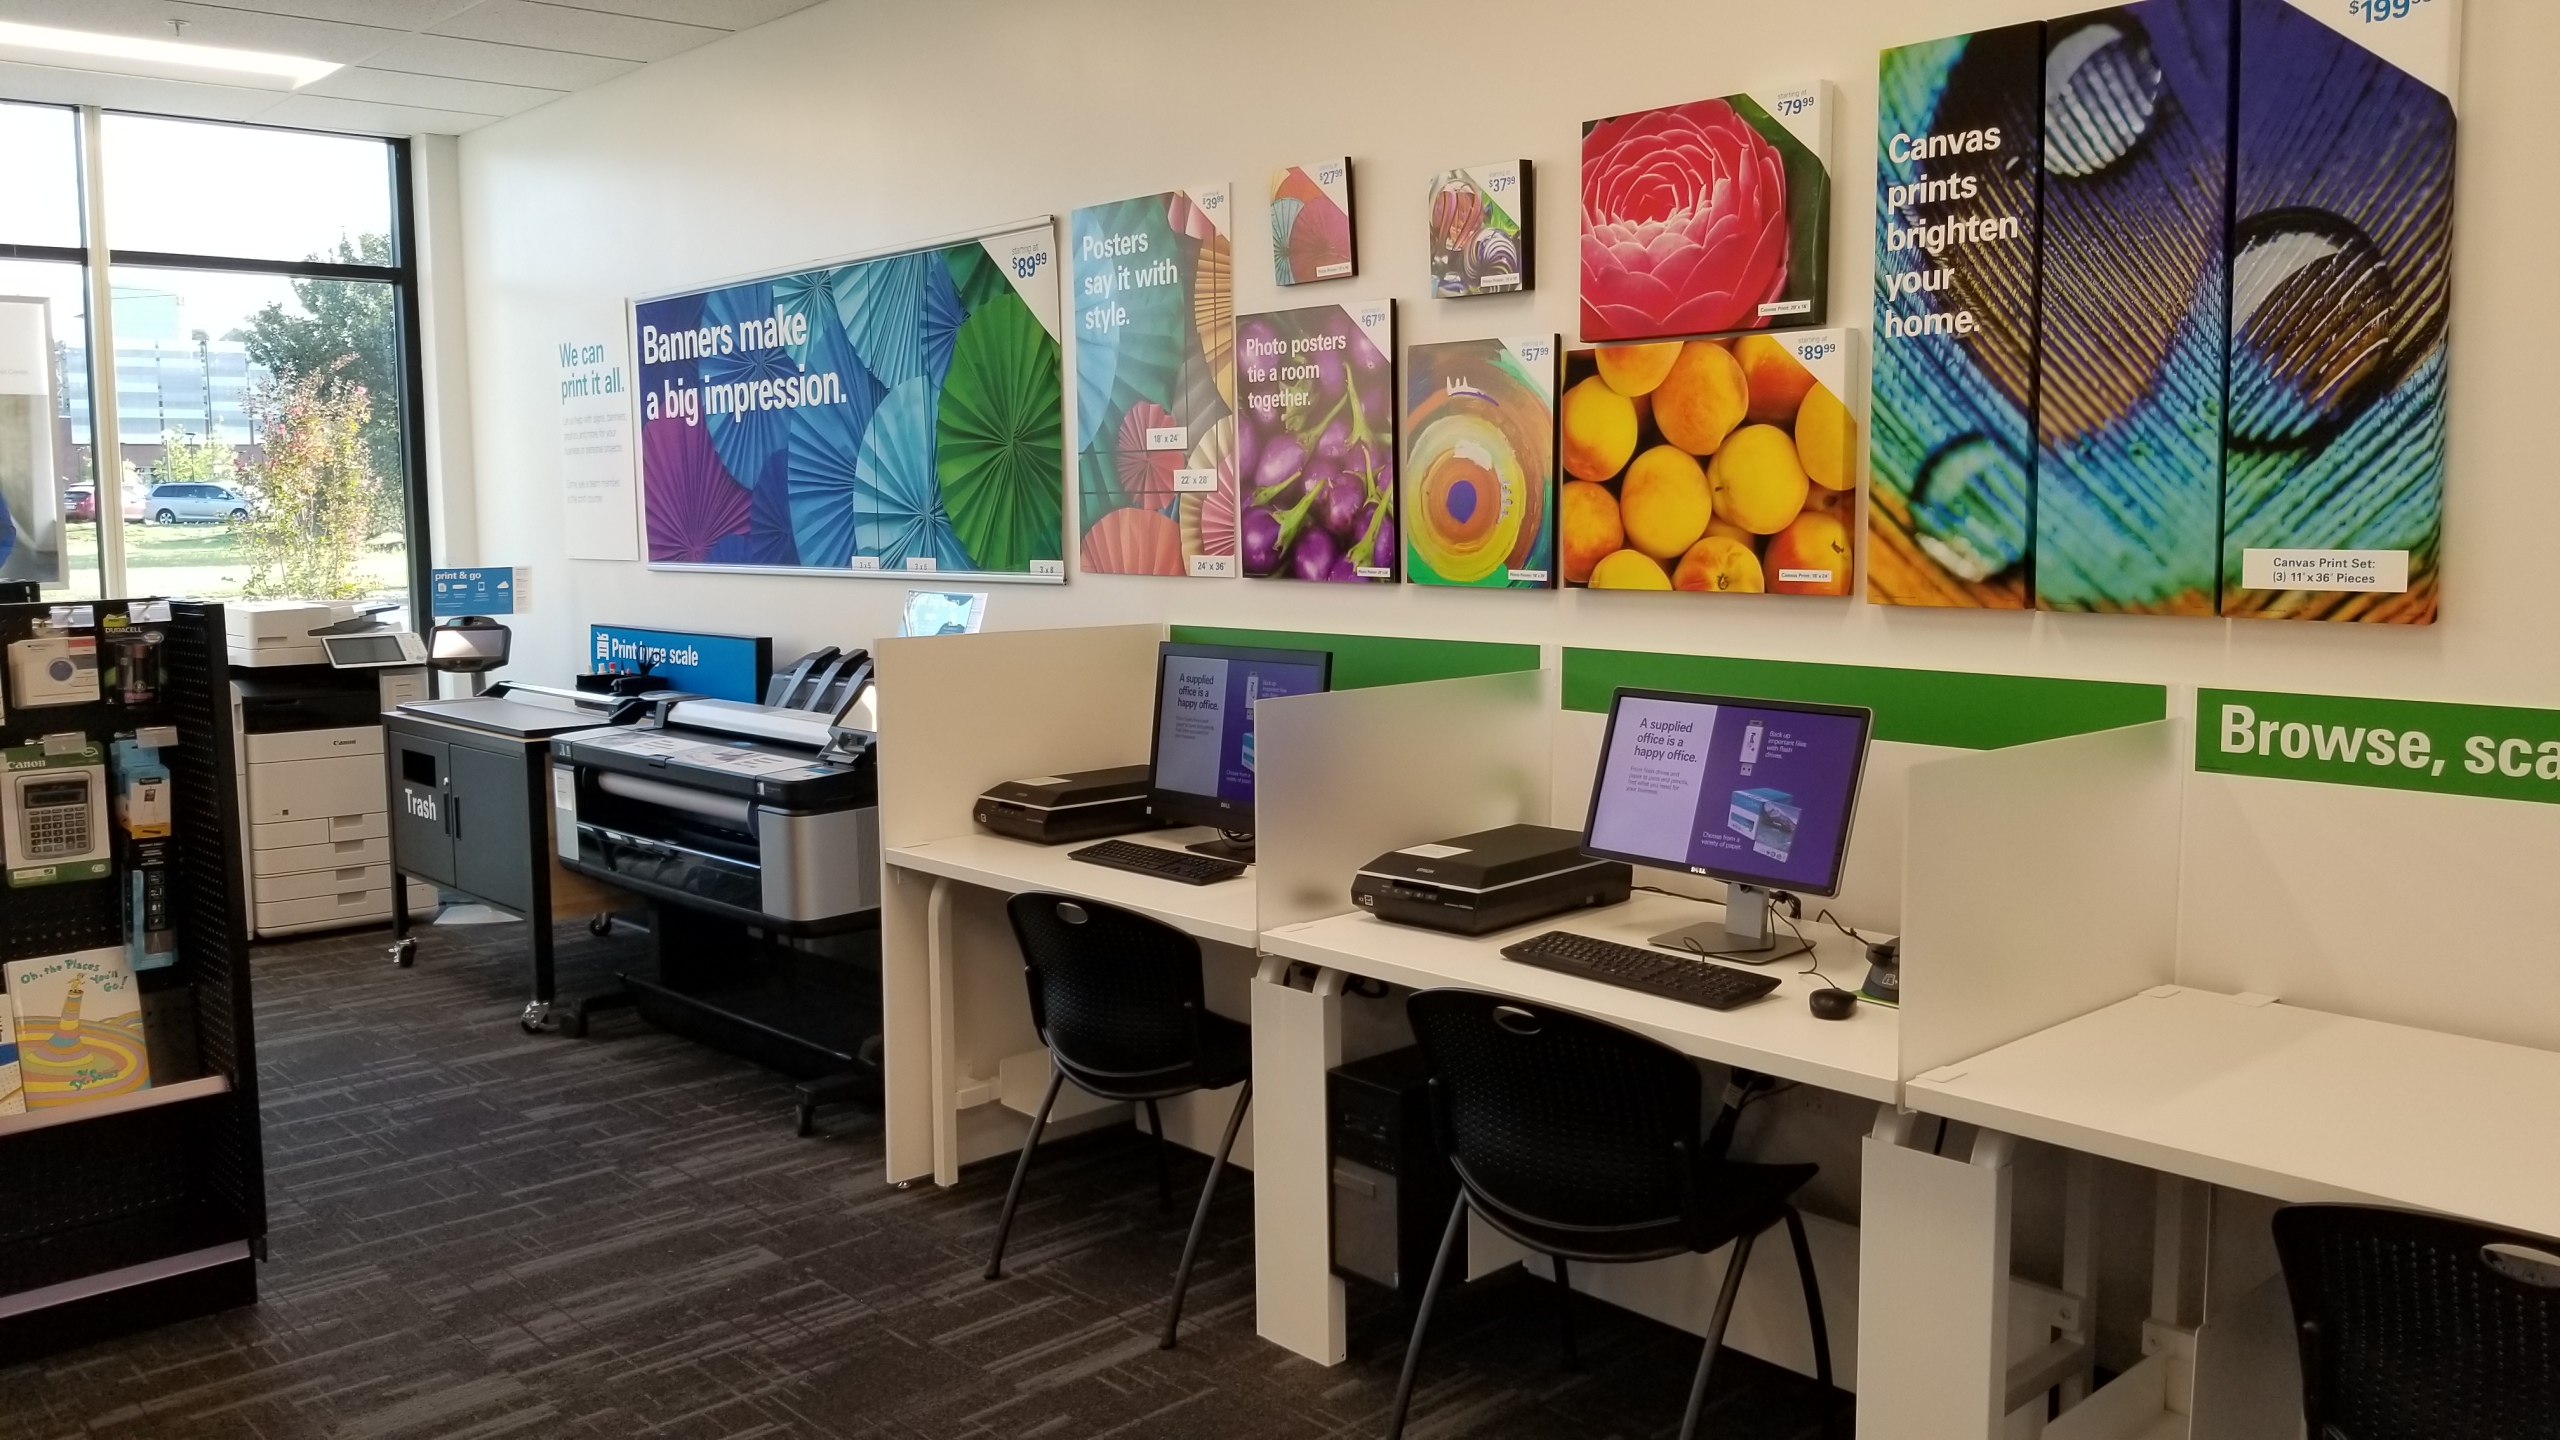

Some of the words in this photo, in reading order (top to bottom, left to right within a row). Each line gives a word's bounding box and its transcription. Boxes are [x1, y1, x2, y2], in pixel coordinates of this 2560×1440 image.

[2349, 0, 2431, 23] $199
[1888, 127, 2001, 164] Canvas
[1888, 172, 1977, 216] prints
[1083, 232, 1148, 261] Posters
[1887, 215, 2018, 254] brighten
[1084, 272, 1112, 299] say
[1118, 264, 1130, 291] it
[1135, 258, 1177, 288] with
[1886, 267, 1955, 302] your
[1085, 301, 1130, 334] style.
[1885, 309, 1980, 338] home.
[643, 323, 733, 365] Banners
[740, 304, 808, 352] make
[1246, 338, 1287, 357] Photo
[1291, 333, 1346, 358] posters
[559, 342, 578, 368] We
[582, 344, 604, 365] can
[1248, 365, 1265, 383] tie
[1269, 369, 1277, 382] a
[1281, 363, 1320, 381] room
[561, 372, 588, 405] print
[591, 370, 601, 395] it
[605, 367, 625, 393] all.
[646, 390, 659, 420] a
[664, 378, 699, 427] big
[704, 364, 847, 423] impression.
[1248, 388, 1311, 412] together.
[2273, 557, 2315, 568] Canvas
[2319, 558, 2348, 568] Print
[2351, 558, 2376, 569] Set:
[435, 572, 457, 581] print
[459, 571, 467, 579] &
[469, 572, 482, 580] go
[2273, 572, 2287, 583] (3)
[2336, 573, 2375, 584] Pieces
[612, 638, 637, 659] Print
[669, 645, 698, 666] scale
[1178, 685, 1196, 696] office
[1198, 687, 1203, 697] is
[1179, 673, 1184, 682] A
[1186, 674, 1214, 686] supplied
[1178, 697, 1198, 710] happy
[1640, 717, 1647, 728] A
[1650, 721, 1693, 733] supplied
[1637, 732, 1664, 745] office
[1667, 735, 1675, 746] is
[1677, 739, 1684, 747] a
[2220, 703, 2446, 778] Browse,
[2464, 735, 2560, 781] sca
[8, 760, 46, 769] Canon
[1634, 745, 1665, 761] happy
[1667, 749, 1697, 762] office.
[405, 788, 436, 821] Trash
[1702, 831, 1722, 840] Choose
[44, 965, 62, 975] the
[64, 959, 100, 972] Places
[103, 976, 128, 992] Go!
